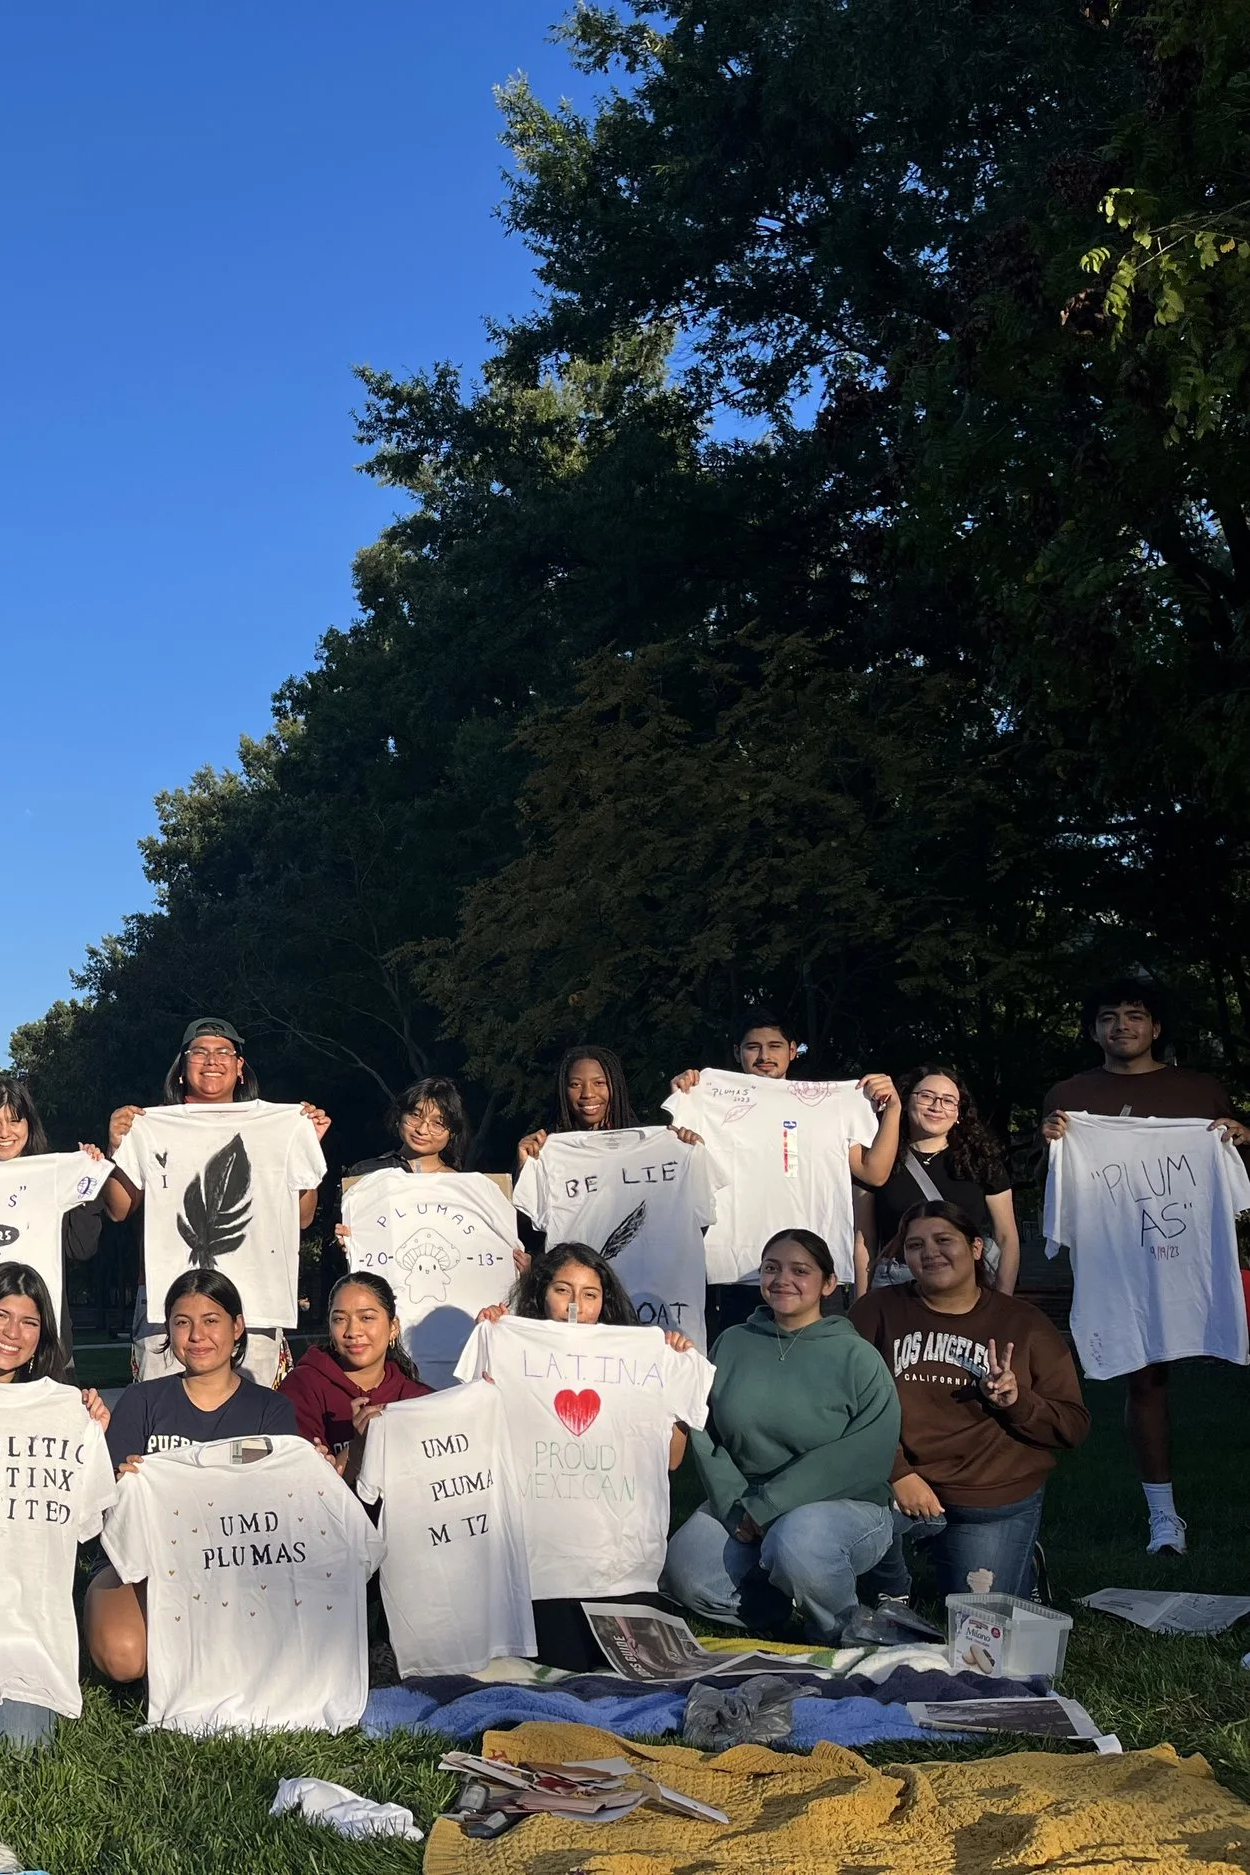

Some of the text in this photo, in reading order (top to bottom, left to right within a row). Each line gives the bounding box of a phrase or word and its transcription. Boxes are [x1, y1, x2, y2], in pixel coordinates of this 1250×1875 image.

[376, 1203, 476, 1236] PLUMAS
[893, 1331, 922, 1378] LOS
[904, 1373, 977, 1388] CALIFORNIA
[421, 1433, 469, 1459] UMD
[535, 1440, 617, 1471] PROUD
[516, 1472, 635, 1502] MEXICAN
[219, 1511, 278, 1537] UMD
[201, 1541, 306, 1570] PLUMAS
[966, 1626, 991, 1642] Milano
